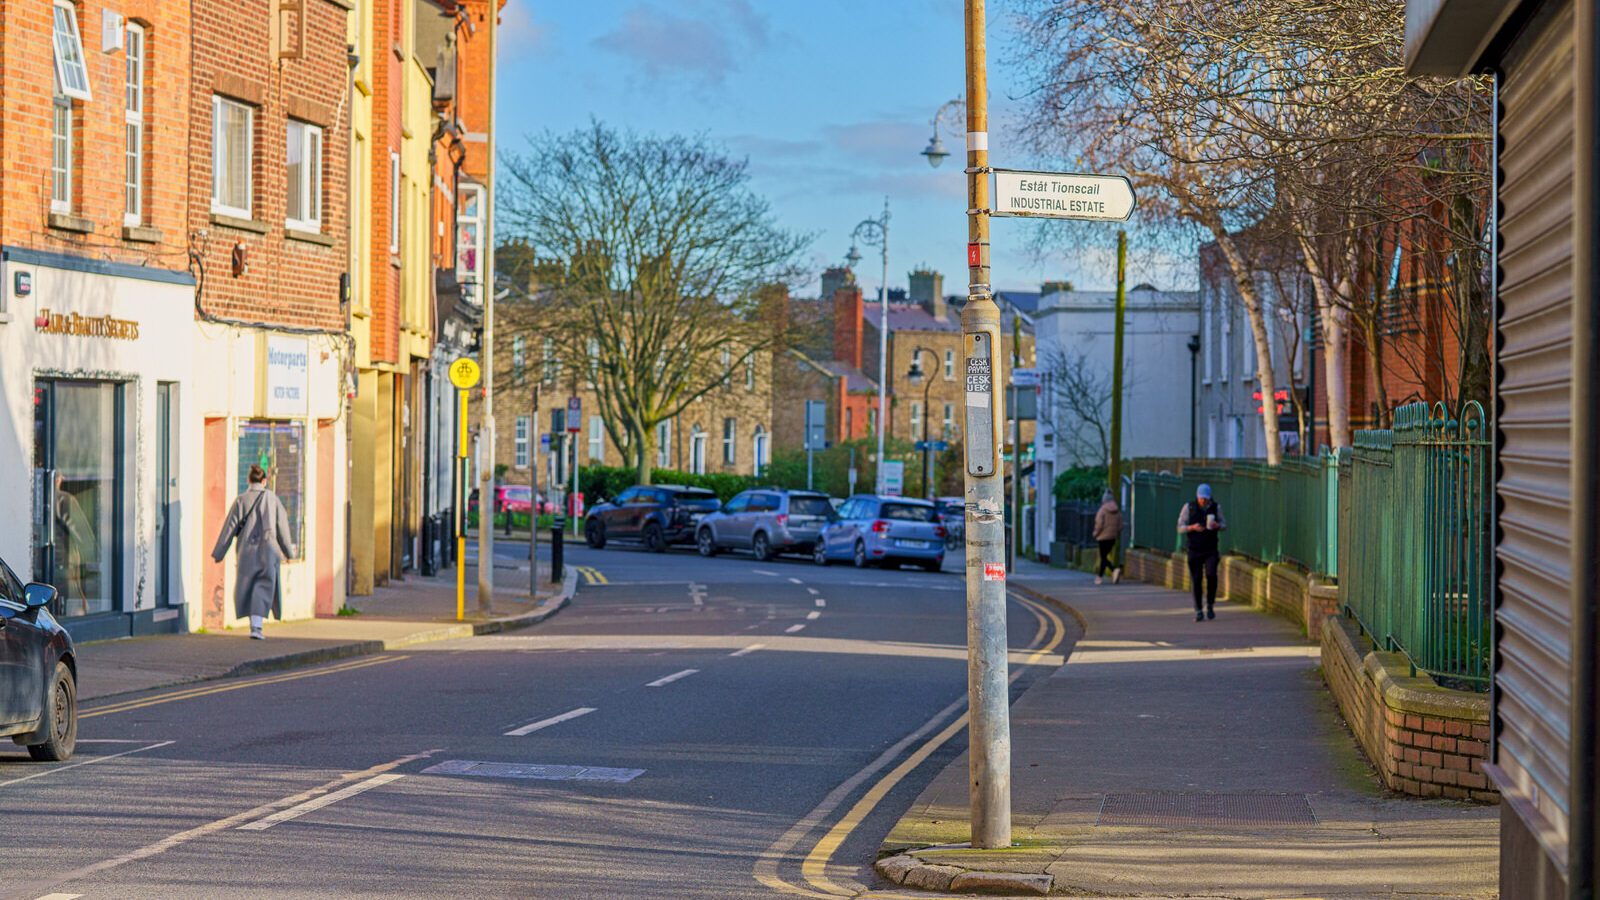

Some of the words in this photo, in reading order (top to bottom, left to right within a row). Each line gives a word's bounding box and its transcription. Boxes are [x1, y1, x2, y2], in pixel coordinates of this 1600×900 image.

[1020, 180, 1047, 192] Estát
[1051, 181, 1100, 195] Tionscail
[1011, 196, 1067, 211] INDUSTRIAL
[1069, 200, 1105, 213] ESTATE
[966, 375, 991, 384] CESK
